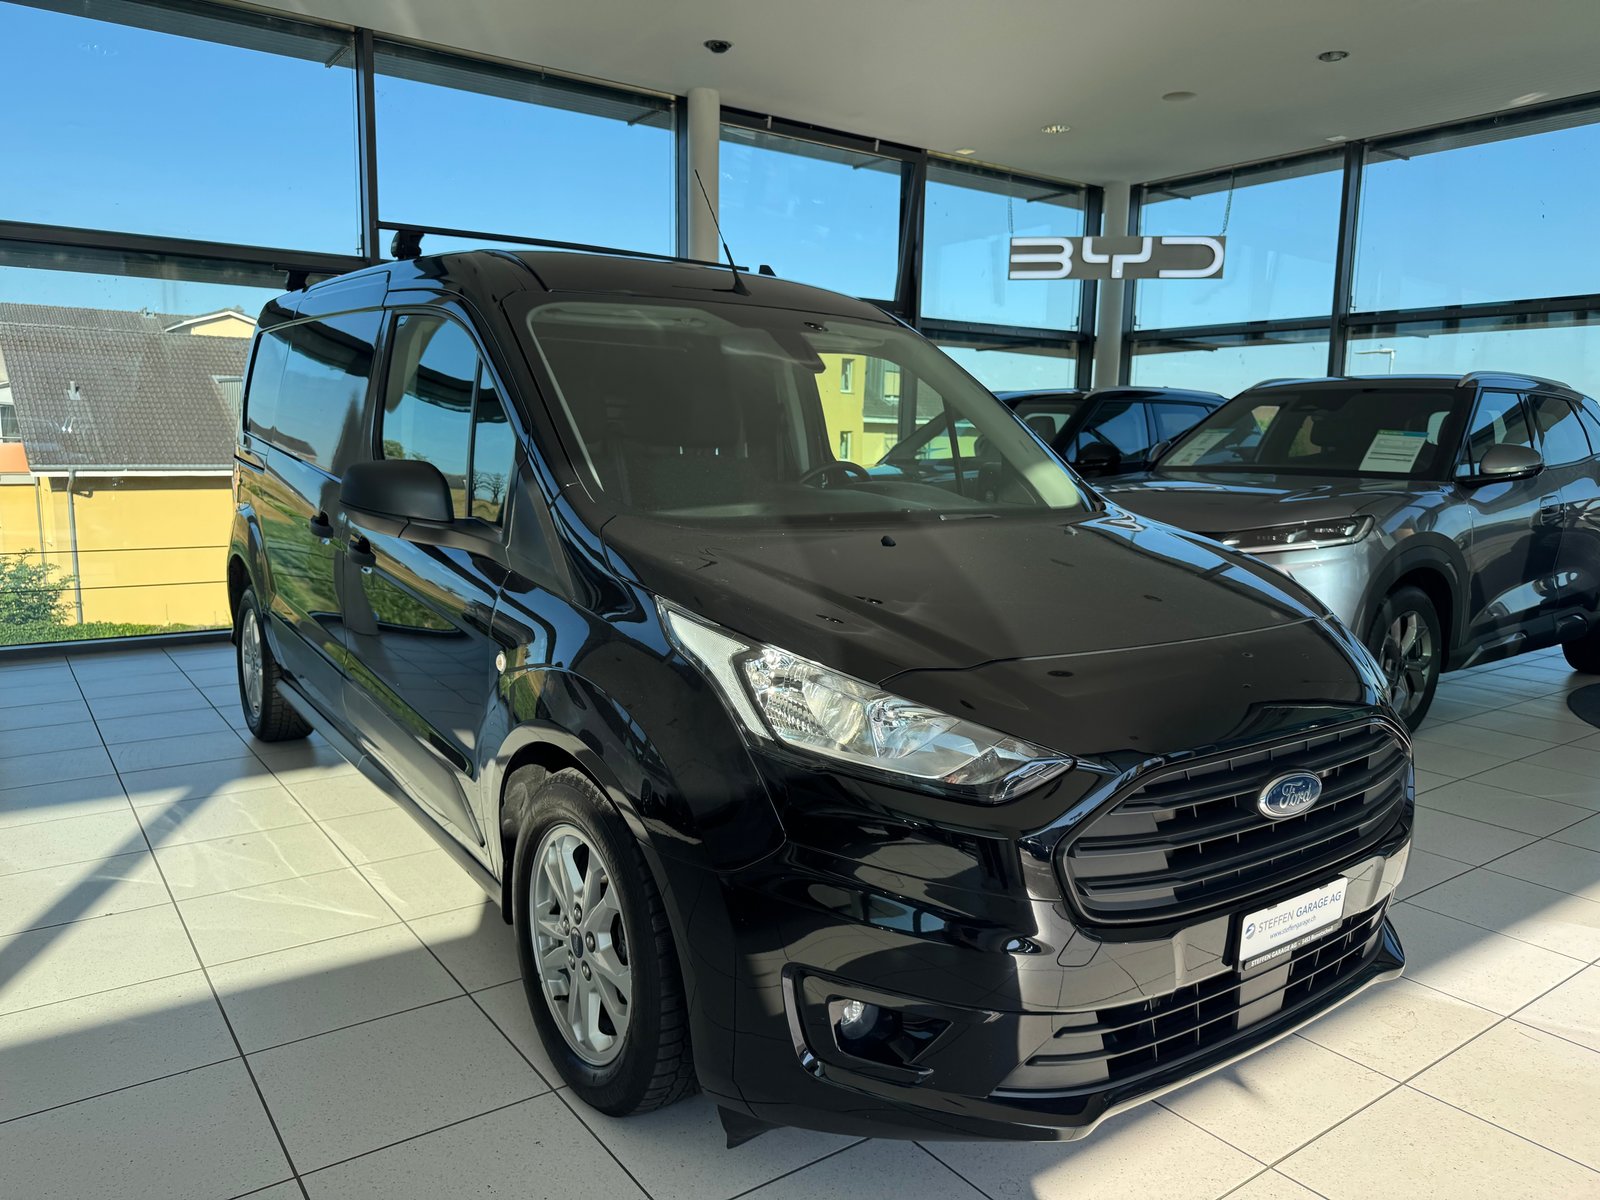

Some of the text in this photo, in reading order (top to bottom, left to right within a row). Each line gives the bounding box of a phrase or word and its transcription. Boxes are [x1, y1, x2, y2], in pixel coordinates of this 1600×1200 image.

[1009, 236, 1224, 279] BYD
[1279, 781, 1311, 808] Ford
[1258, 891, 1342, 933] STEFFEN GARAGE AG
[1269, 915, 1317, 939] www.steffengarage.ch
[1251, 954, 1271, 966] STEFFEN
[1271, 945, 1289, 957] GARAGE
[1289, 942, 1298, 951] AG
